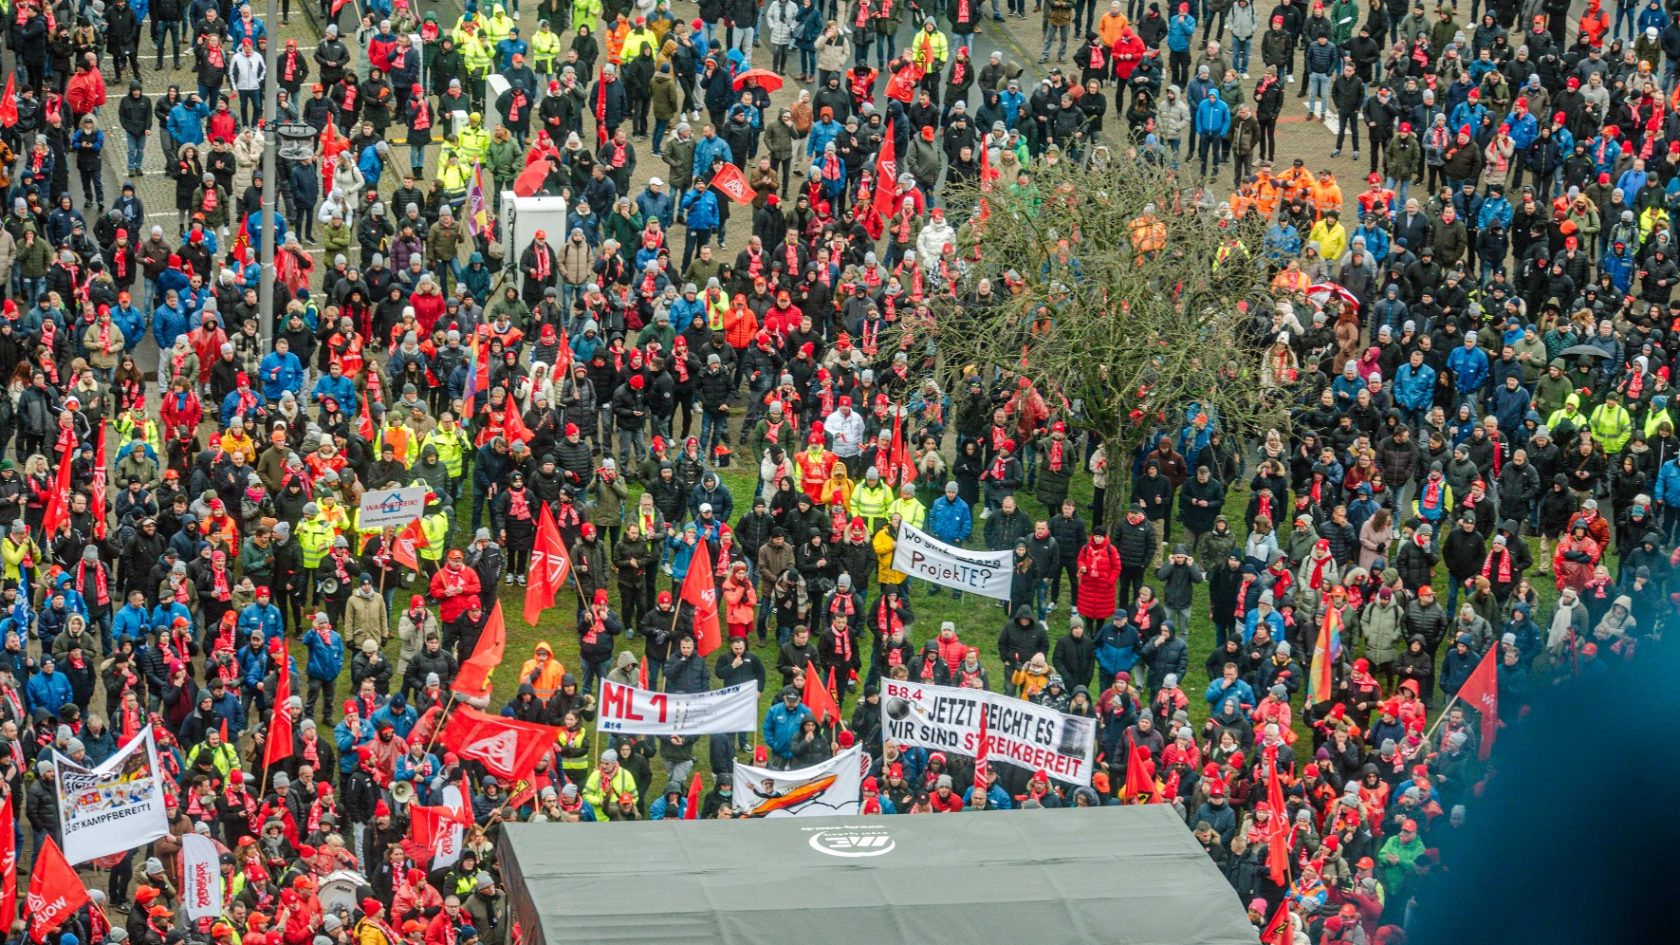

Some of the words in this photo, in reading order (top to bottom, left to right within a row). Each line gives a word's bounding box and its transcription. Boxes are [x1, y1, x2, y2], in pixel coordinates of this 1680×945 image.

[911, 550, 992, 588] ProjekTE?
[602, 682, 644, 721] ML
[649, 694, 667, 723] 1
[888, 684, 922, 700] B8.4
[604, 722, 622, 730] B14
[928, 696, 976, 726] JETZT
[1035, 716, 1054, 746] ES
[920, 725, 958, 747] SIND
[964, 733, 1082, 778] SREIKBEREIT
[81, 802, 151, 828] KAMPFBEREIT!
